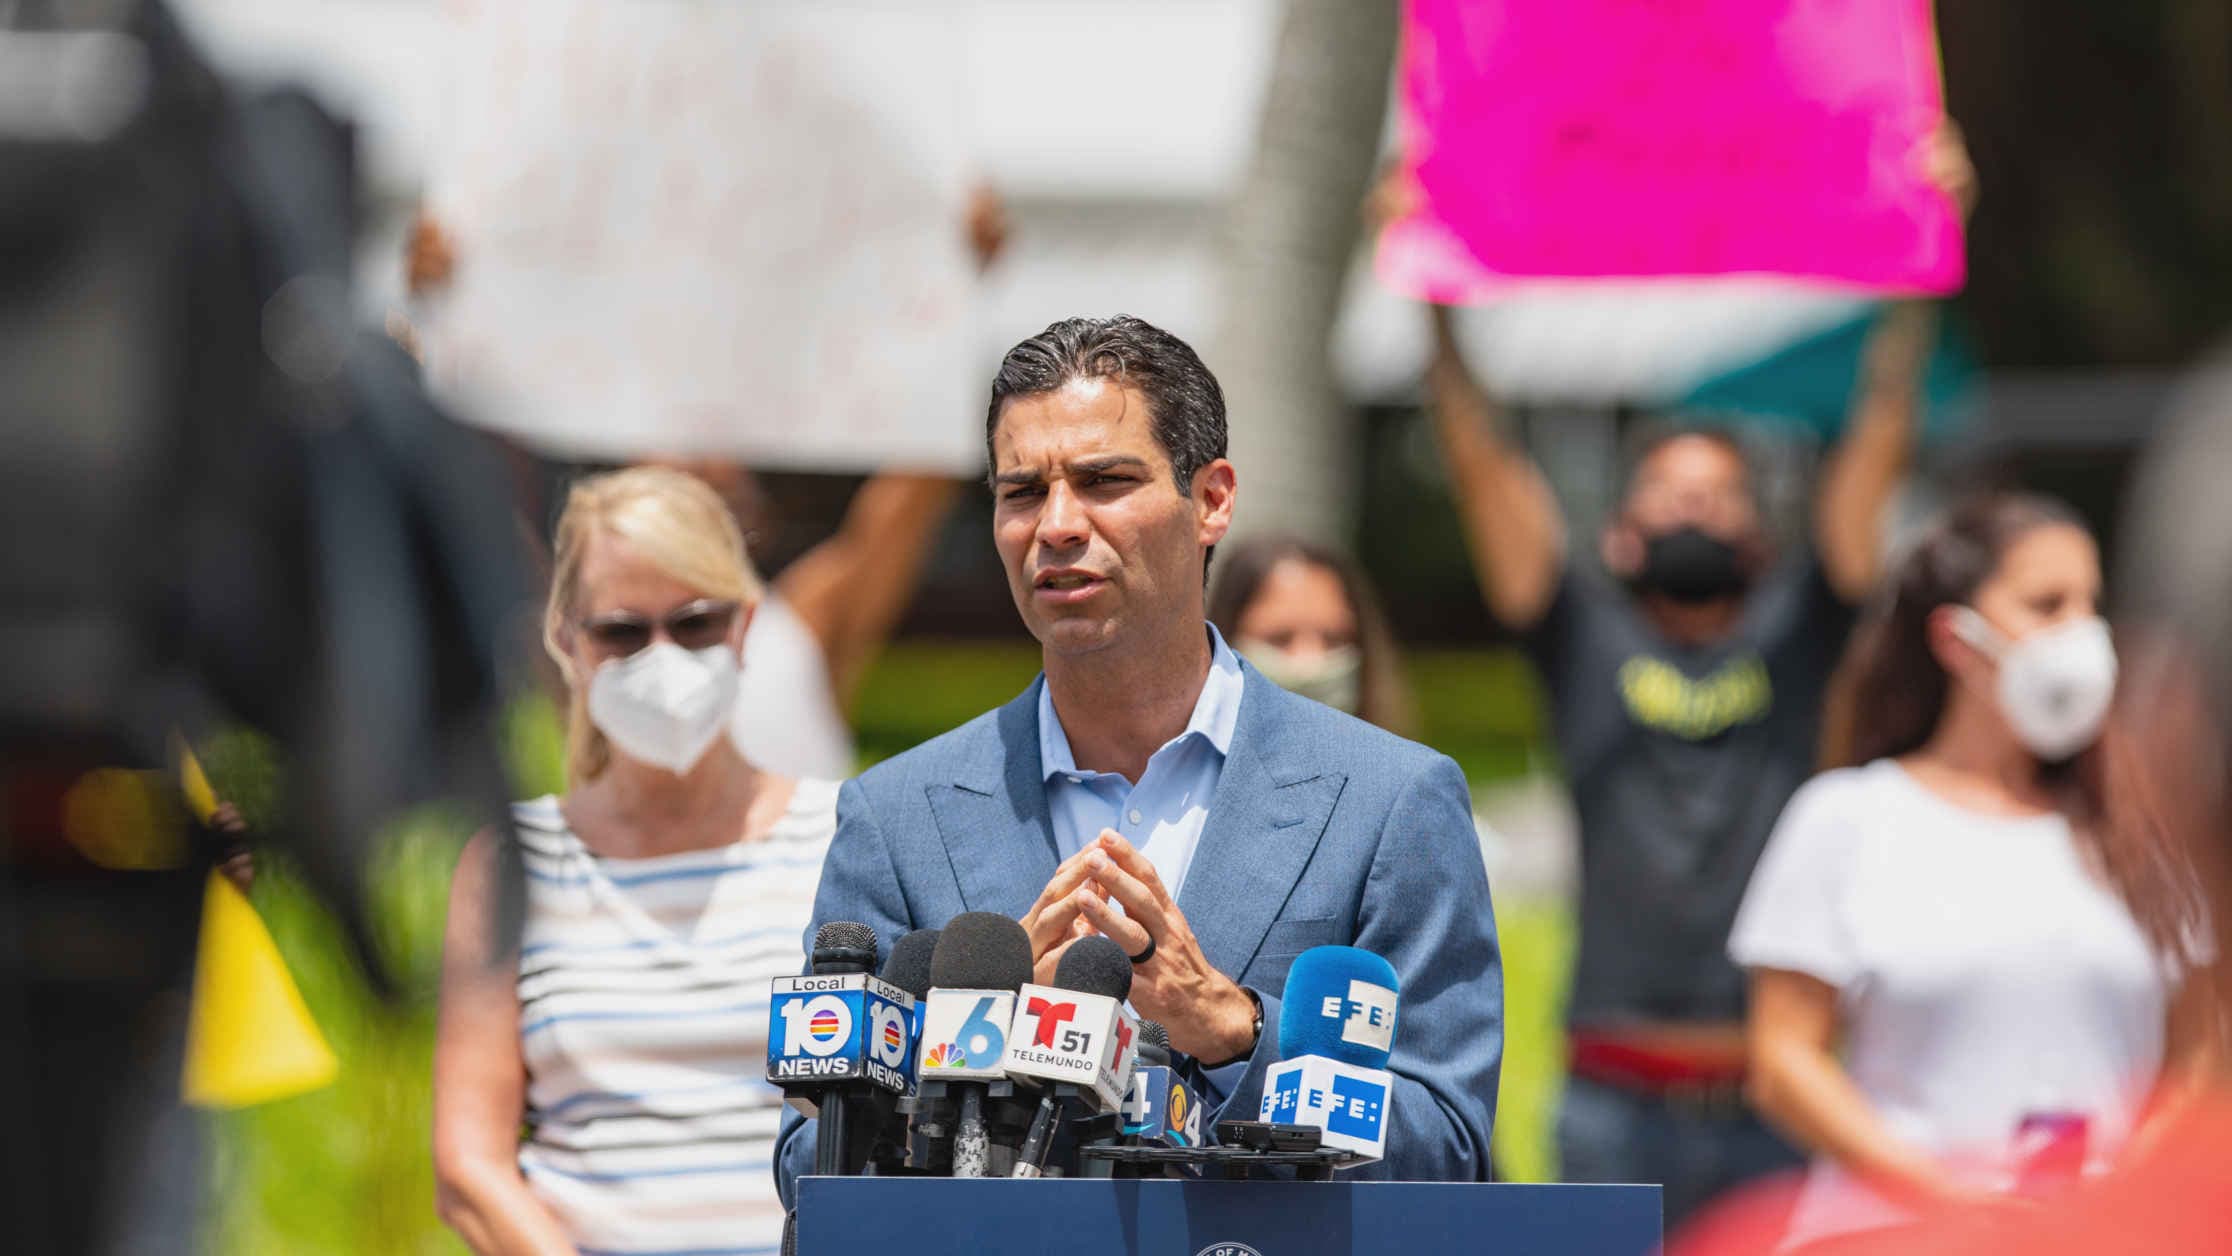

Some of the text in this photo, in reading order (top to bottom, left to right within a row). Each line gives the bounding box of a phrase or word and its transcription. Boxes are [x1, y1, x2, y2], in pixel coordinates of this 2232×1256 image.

[792, 977, 845, 991] Local
[877, 981, 905, 1004] Local
[781, 994, 852, 1057] 10
[870, 1001, 907, 1068] 10
[956, 997, 1004, 1069] 6
[1061, 1030, 1091, 1054] 51
[777, 1058, 849, 1076] NEWS
[1013, 1049, 1093, 1071] TELEMUNDO
[867, 1061, 904, 1090] NEWS
[1120, 1072, 1151, 1122] 4
[1185, 1100, 1202, 1149] 4
